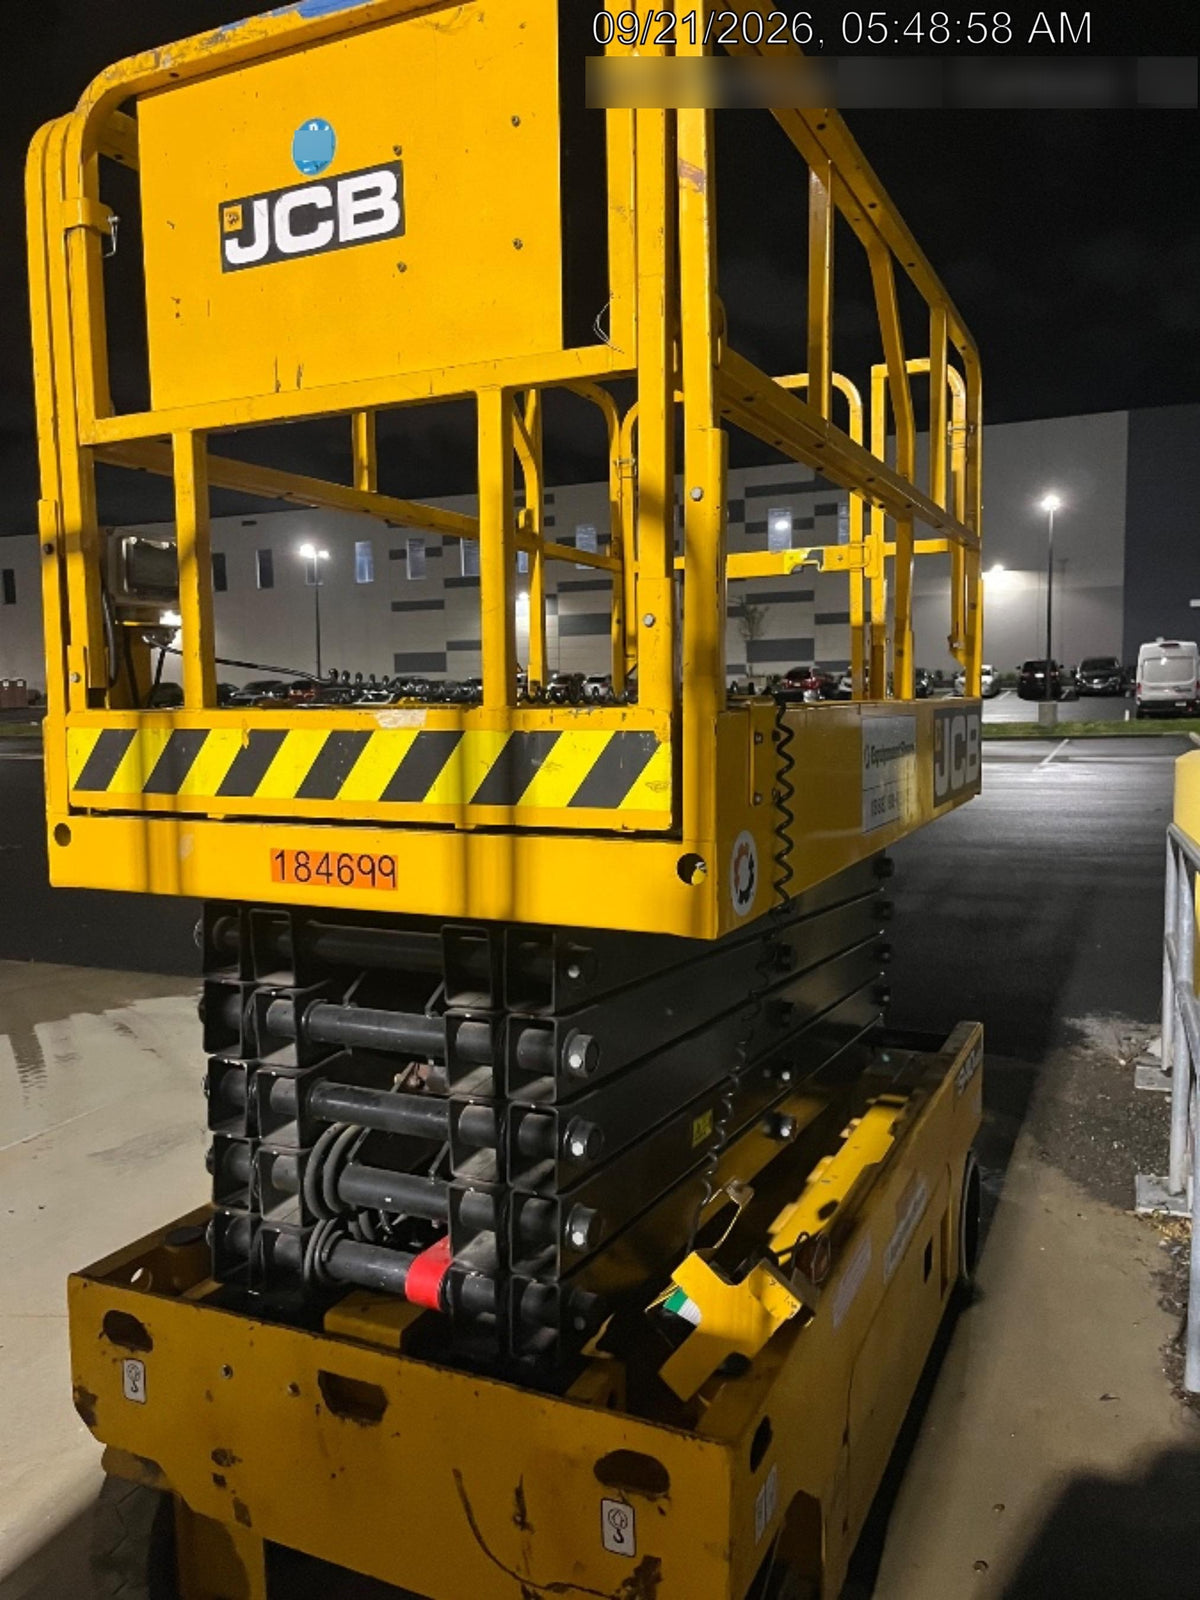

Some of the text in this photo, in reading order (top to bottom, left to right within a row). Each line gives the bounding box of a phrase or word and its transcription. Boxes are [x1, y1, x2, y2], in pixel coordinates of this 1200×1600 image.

[224, 170, 400, 264] JCB
[934, 713, 979, 797] JCB
[275, 850, 396, 888] 184699
